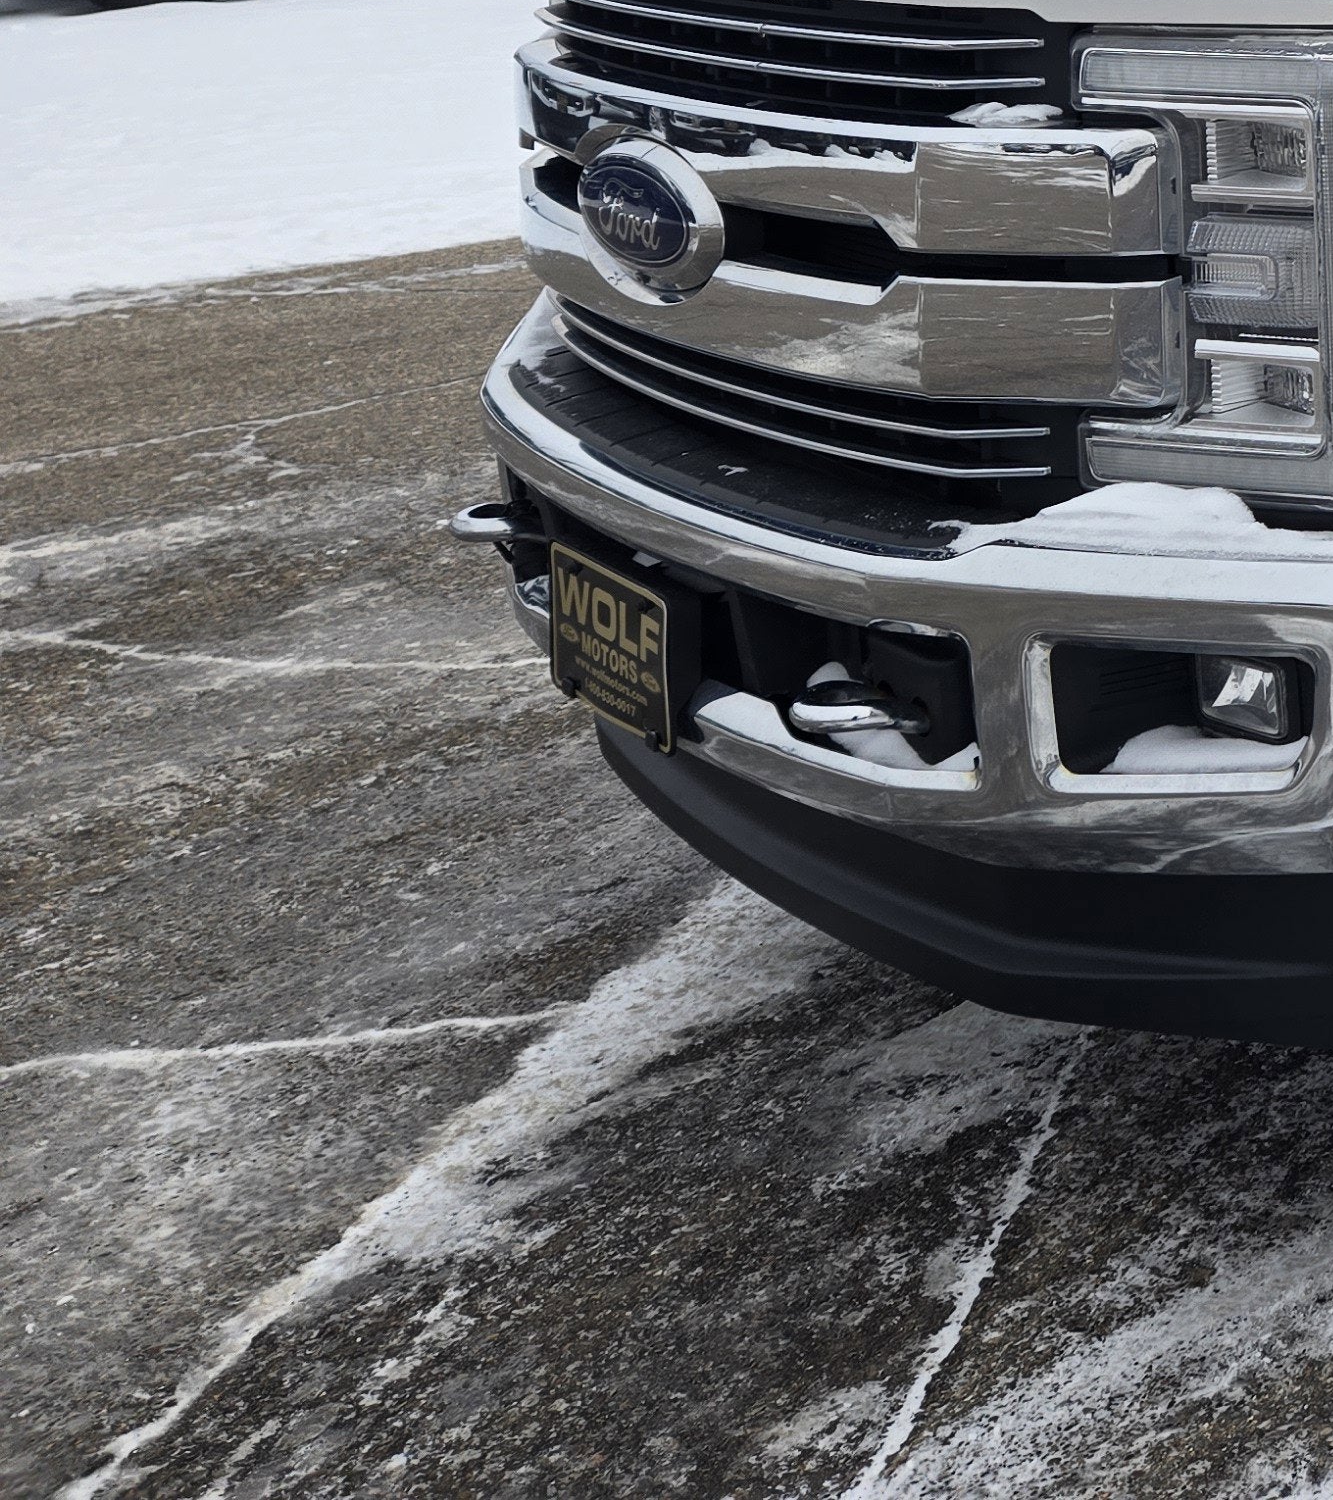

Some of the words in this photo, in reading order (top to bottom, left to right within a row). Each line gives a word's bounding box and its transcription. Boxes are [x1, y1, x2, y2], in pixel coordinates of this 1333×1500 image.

[598, 177, 661, 251] Ford
[557, 566, 660, 663] WOLF
[581, 631, 638, 684] MOTORS
